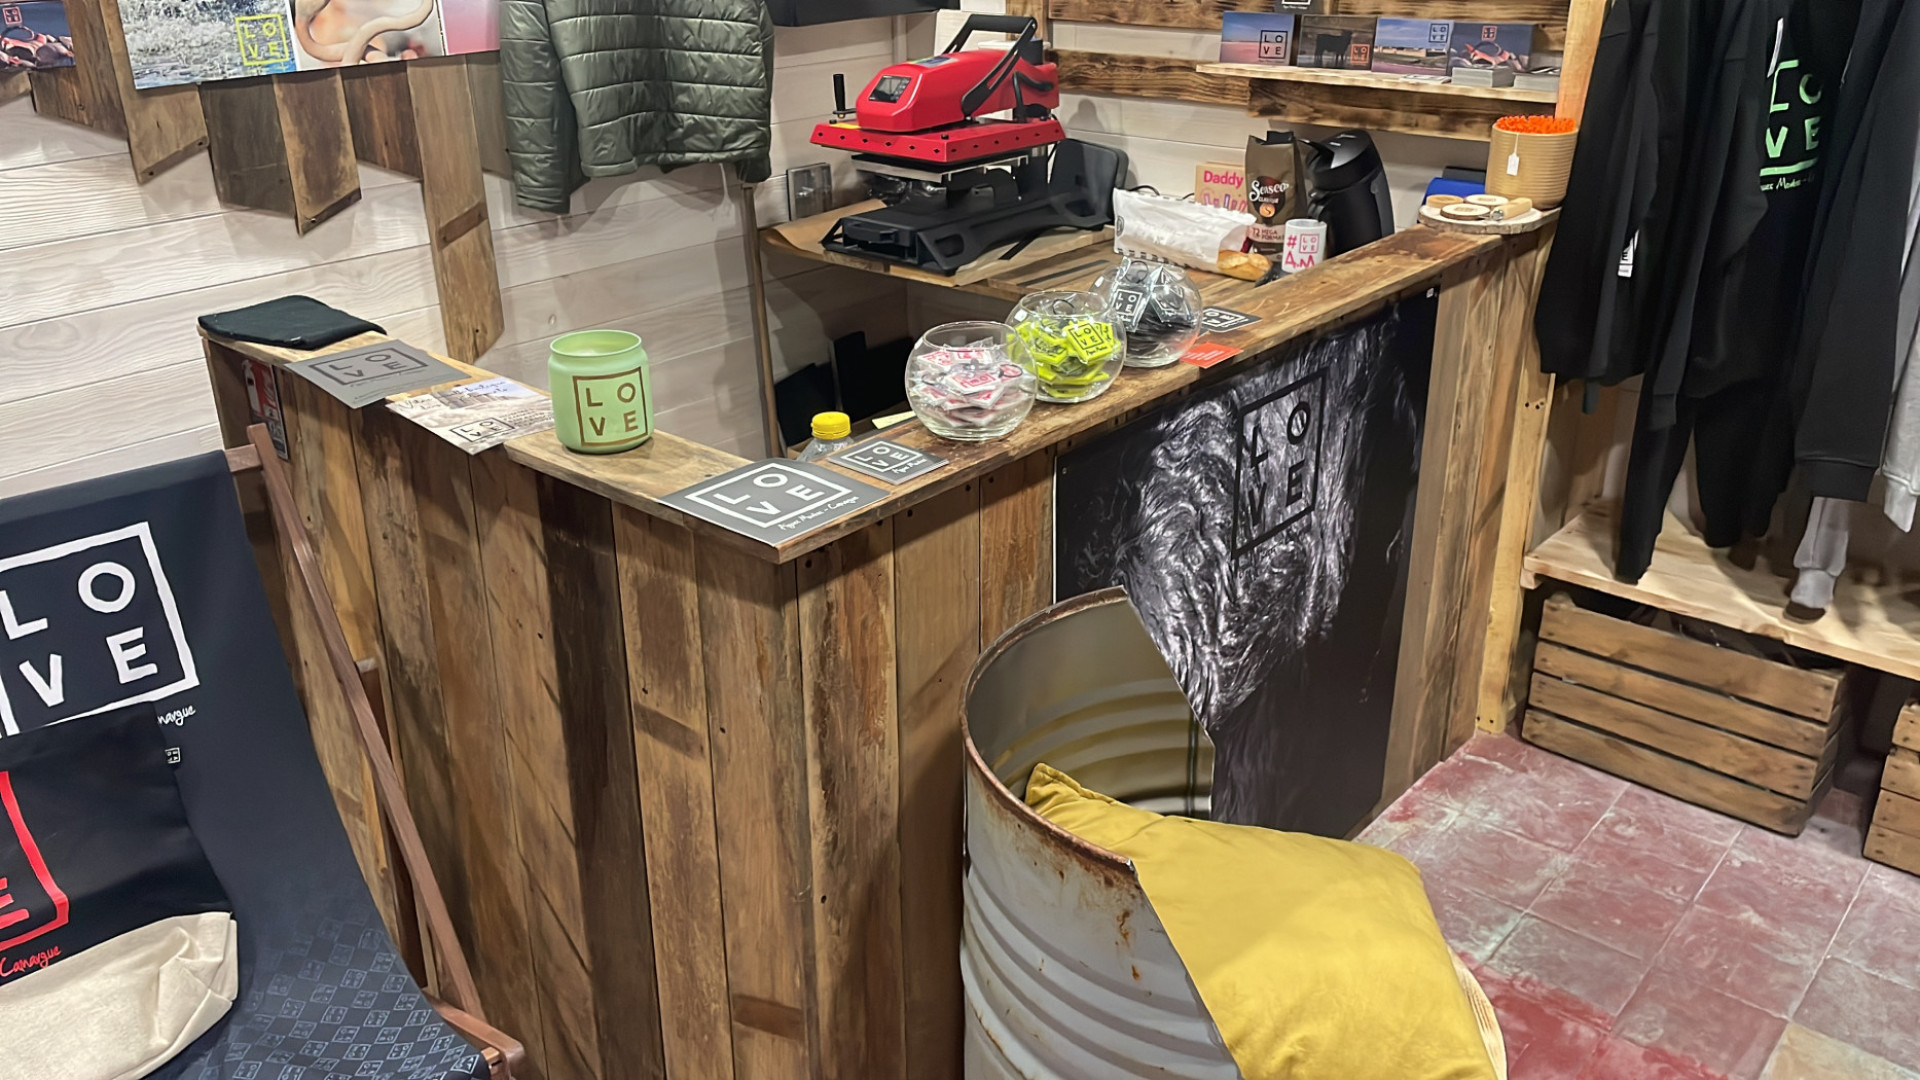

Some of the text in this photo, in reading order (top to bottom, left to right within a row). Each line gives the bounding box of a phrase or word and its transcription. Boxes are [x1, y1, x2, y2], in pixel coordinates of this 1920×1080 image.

[1203, 170, 1244, 190] Daddy
[585, 383, 636, 407] LO
[589, 410, 639, 436] VE
[713, 473, 788, 505] LO
[745, 484, 825, 515] VE
[0, 561, 136, 641] LO
[19, 626, 158, 708] VE
